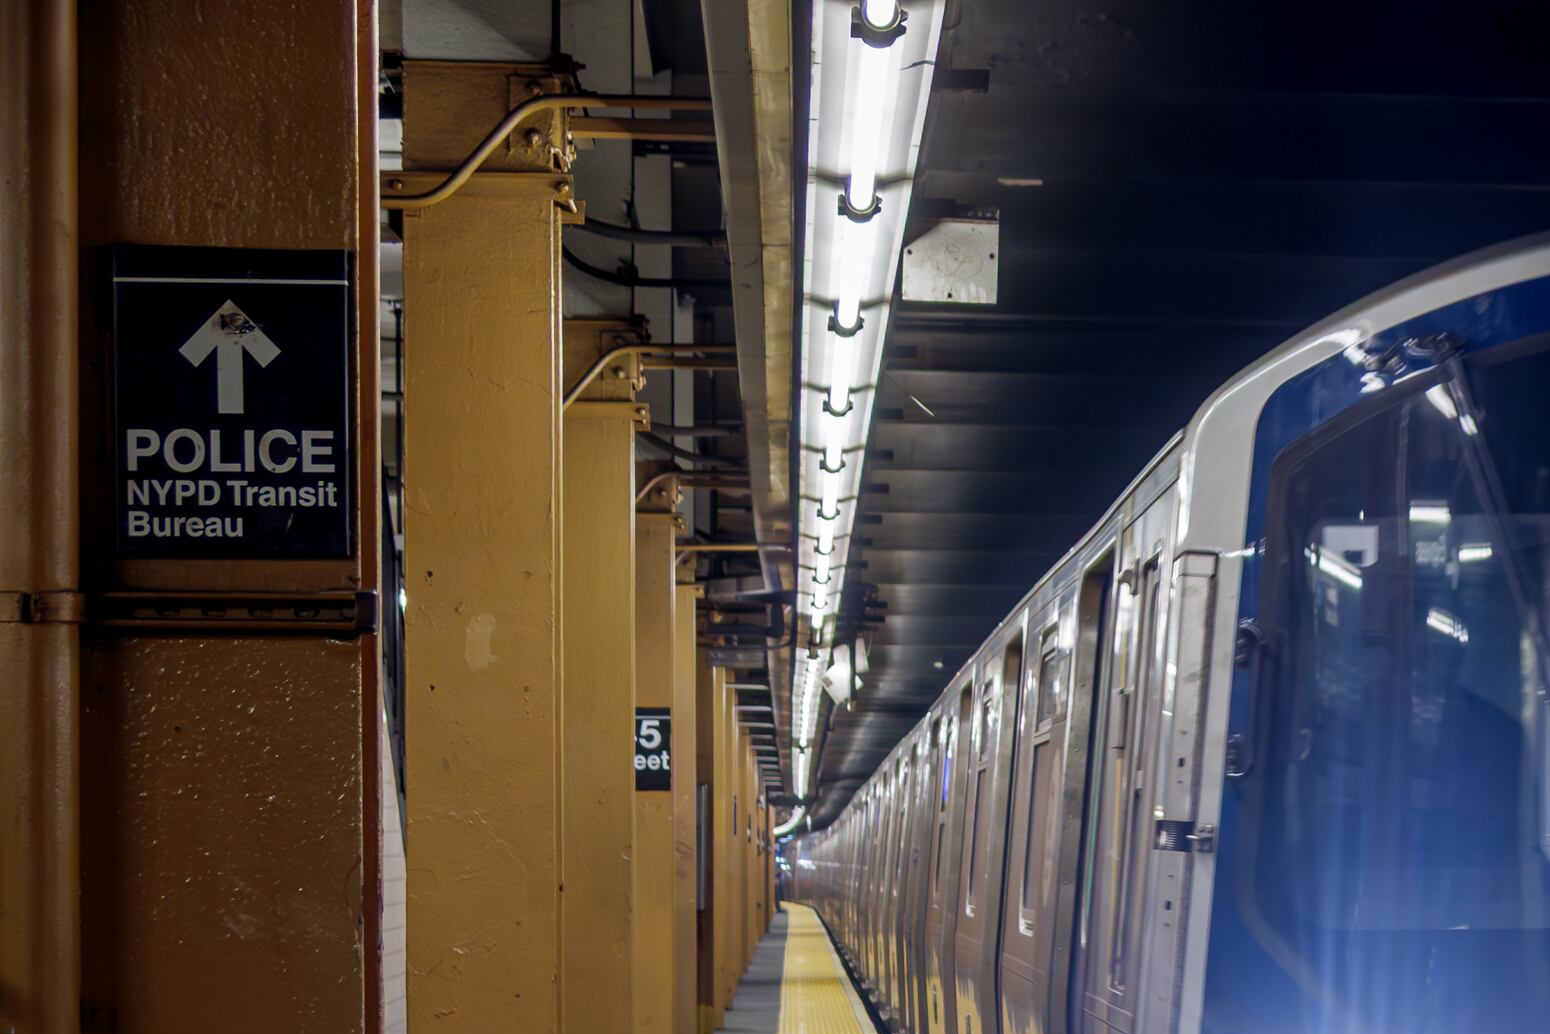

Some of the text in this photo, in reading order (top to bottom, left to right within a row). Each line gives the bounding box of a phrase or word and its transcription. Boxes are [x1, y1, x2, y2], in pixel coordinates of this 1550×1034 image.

[126, 428, 336, 474] POLICE
[127, 479, 337, 507] NYPD Transit
[128, 511, 244, 538] Bureau
[634, 719, 662, 749] 5
